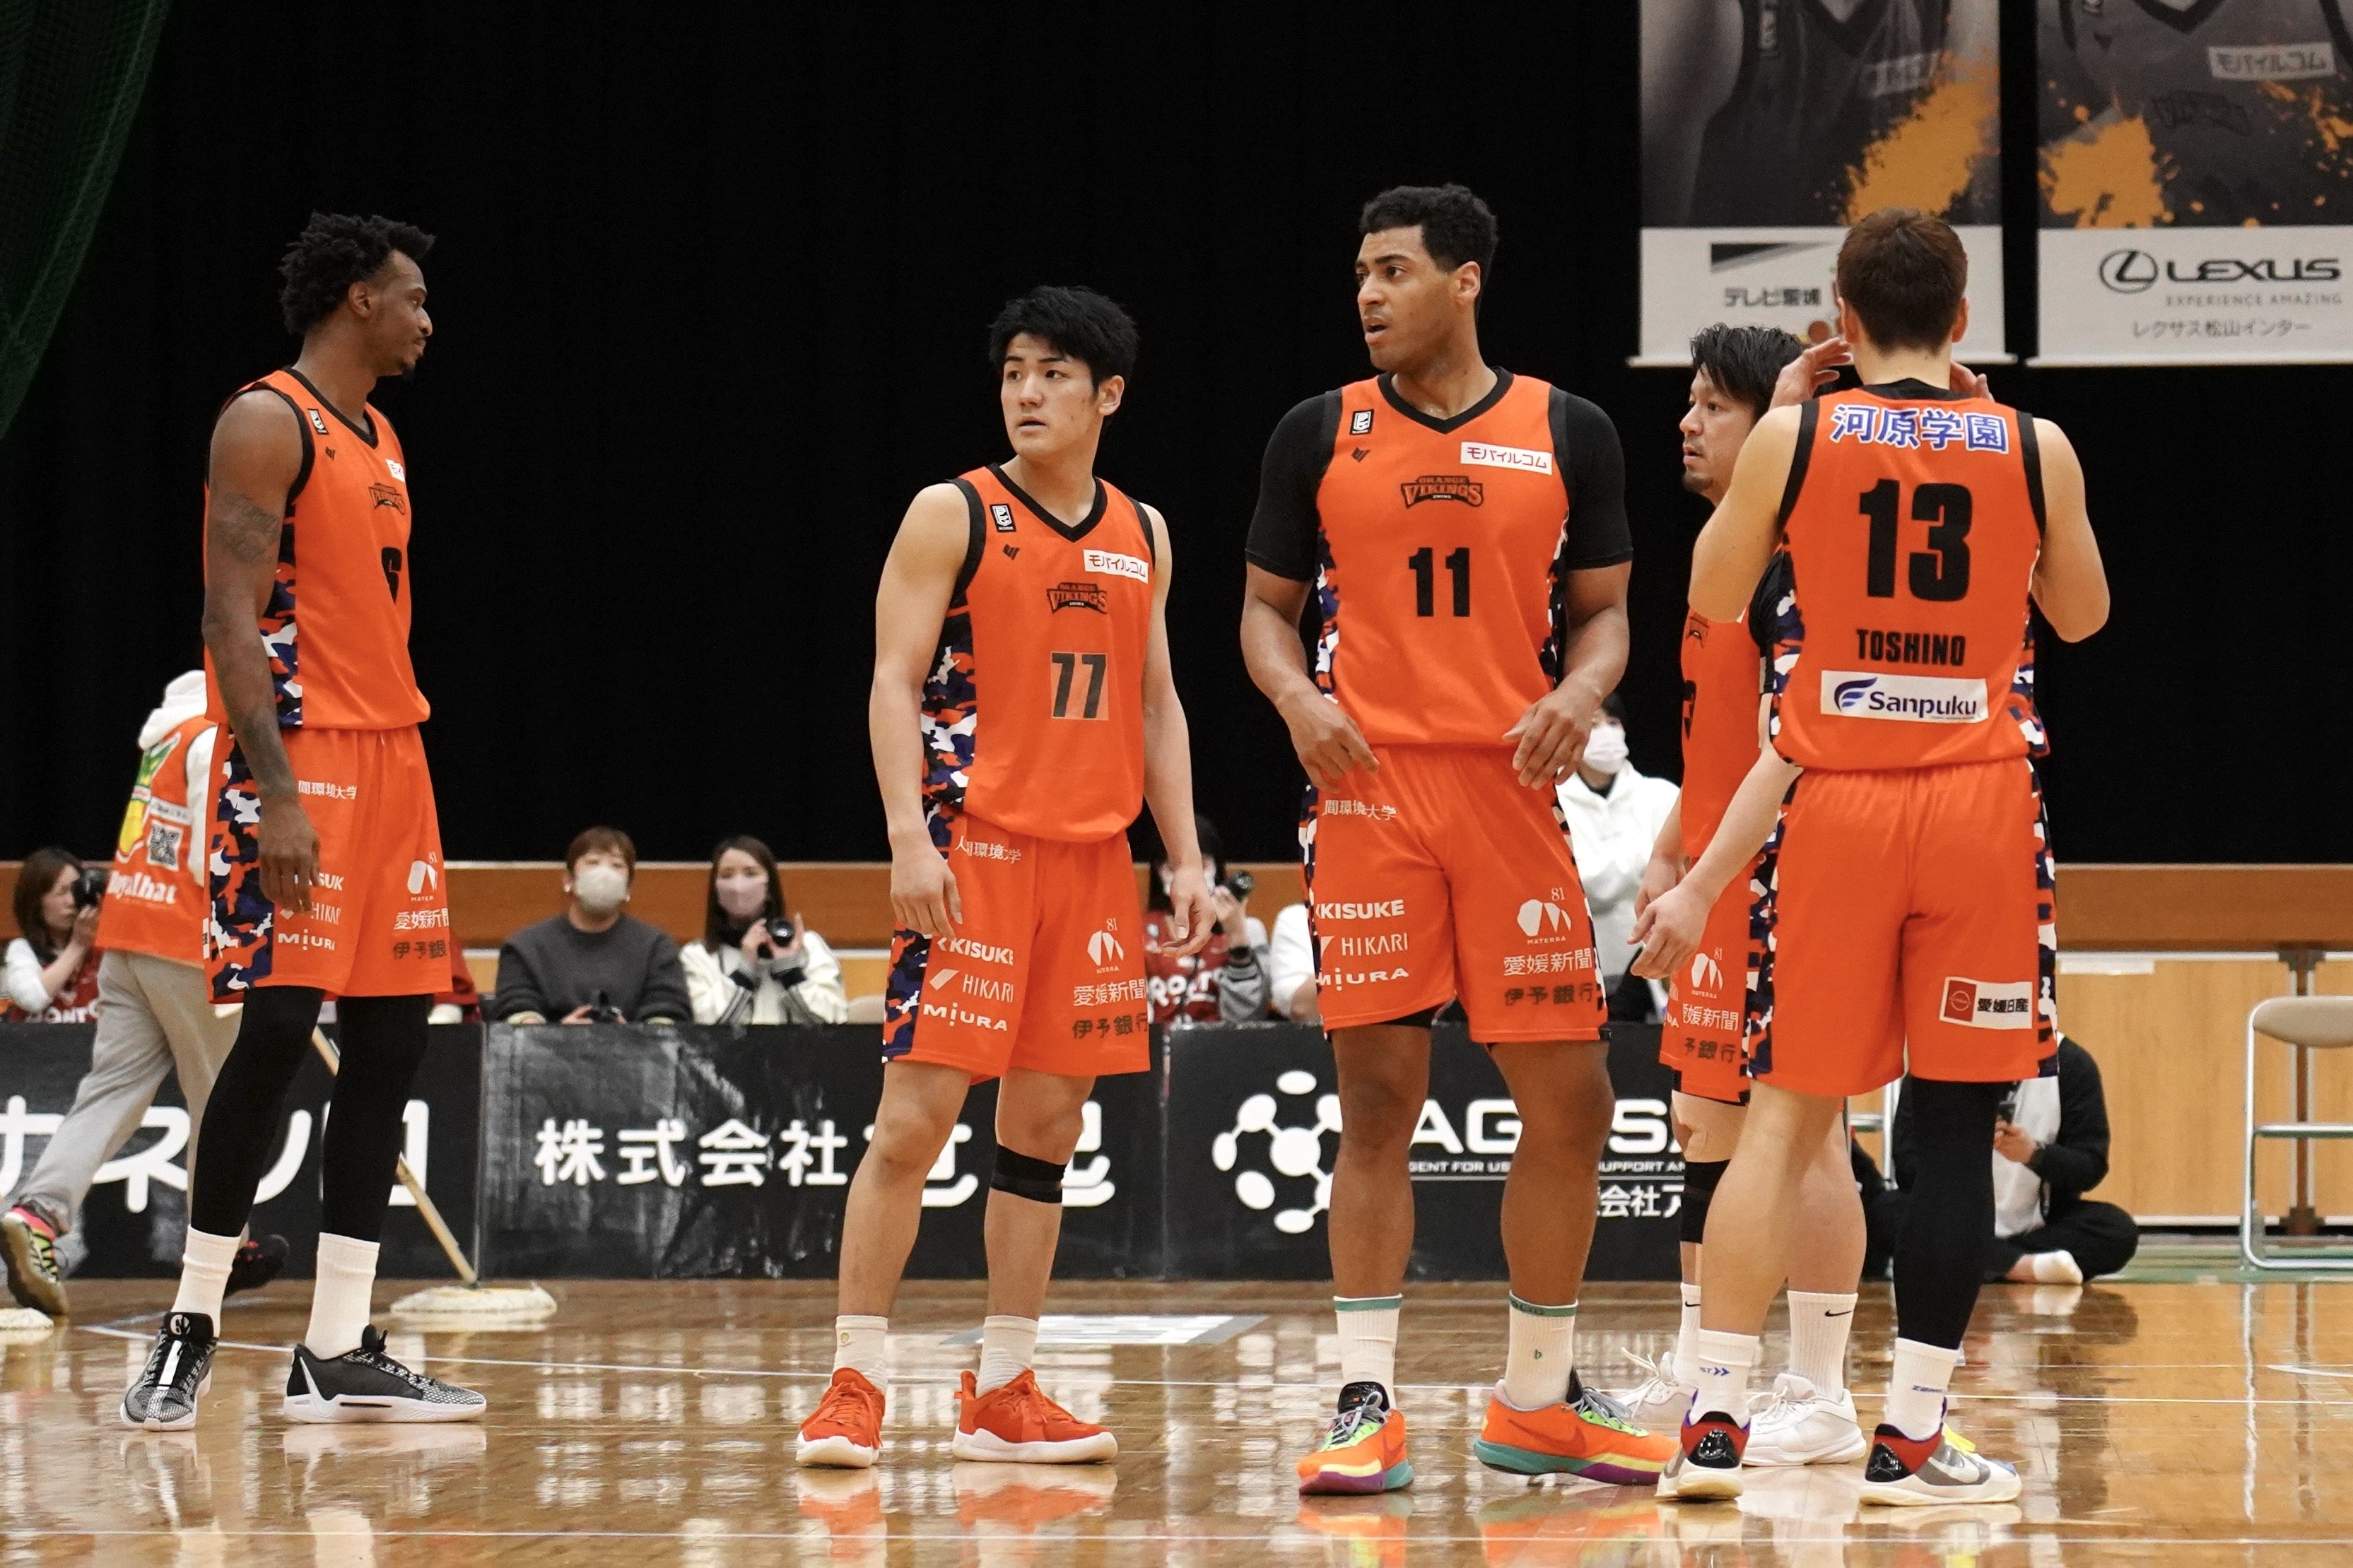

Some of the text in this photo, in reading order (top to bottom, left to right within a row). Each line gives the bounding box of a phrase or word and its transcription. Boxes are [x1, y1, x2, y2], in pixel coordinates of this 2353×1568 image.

[2166, 259, 2342, 282] LEXUS
[1830, 403, 2009, 454] 河原学園
[1467, 447, 1548, 469] モバイルコム
[1401, 483, 1484, 509] VIKINGS
[1858, 478, 1973, 603] 13
[1089, 554, 1147, 578] モバイルコム
[1409, 547, 1471, 617] 11
[1855, 628, 1966, 667] TOSHINO
[1051, 653, 1108, 719] 77
[1868, 691, 1977, 719] Sanpuku
[298, 779, 358, 800] 間環境大学
[1321, 799, 1397, 821] 間環境大学
[1551, 887, 1566, 902] 81
[1106, 918, 1118, 931] 81
[393, 939, 447, 960] 伊予銀
[1342, 932, 1408, 956] HIKARI
[1714, 947, 1723, 961] 81
[1503, 948, 1592, 977] 愛媛新聞
[962, 974, 1014, 1003] HIKARI
[1073, 978, 1148, 1007] 愛媛新聞
[1504, 982, 1592, 1006] 伊予銀行
[1684, 1037, 1735, 1063] 予銀行
[1598, 1161, 1664, 1173] UPPORT
[1597, 1184, 1685, 1218] 会社ア
